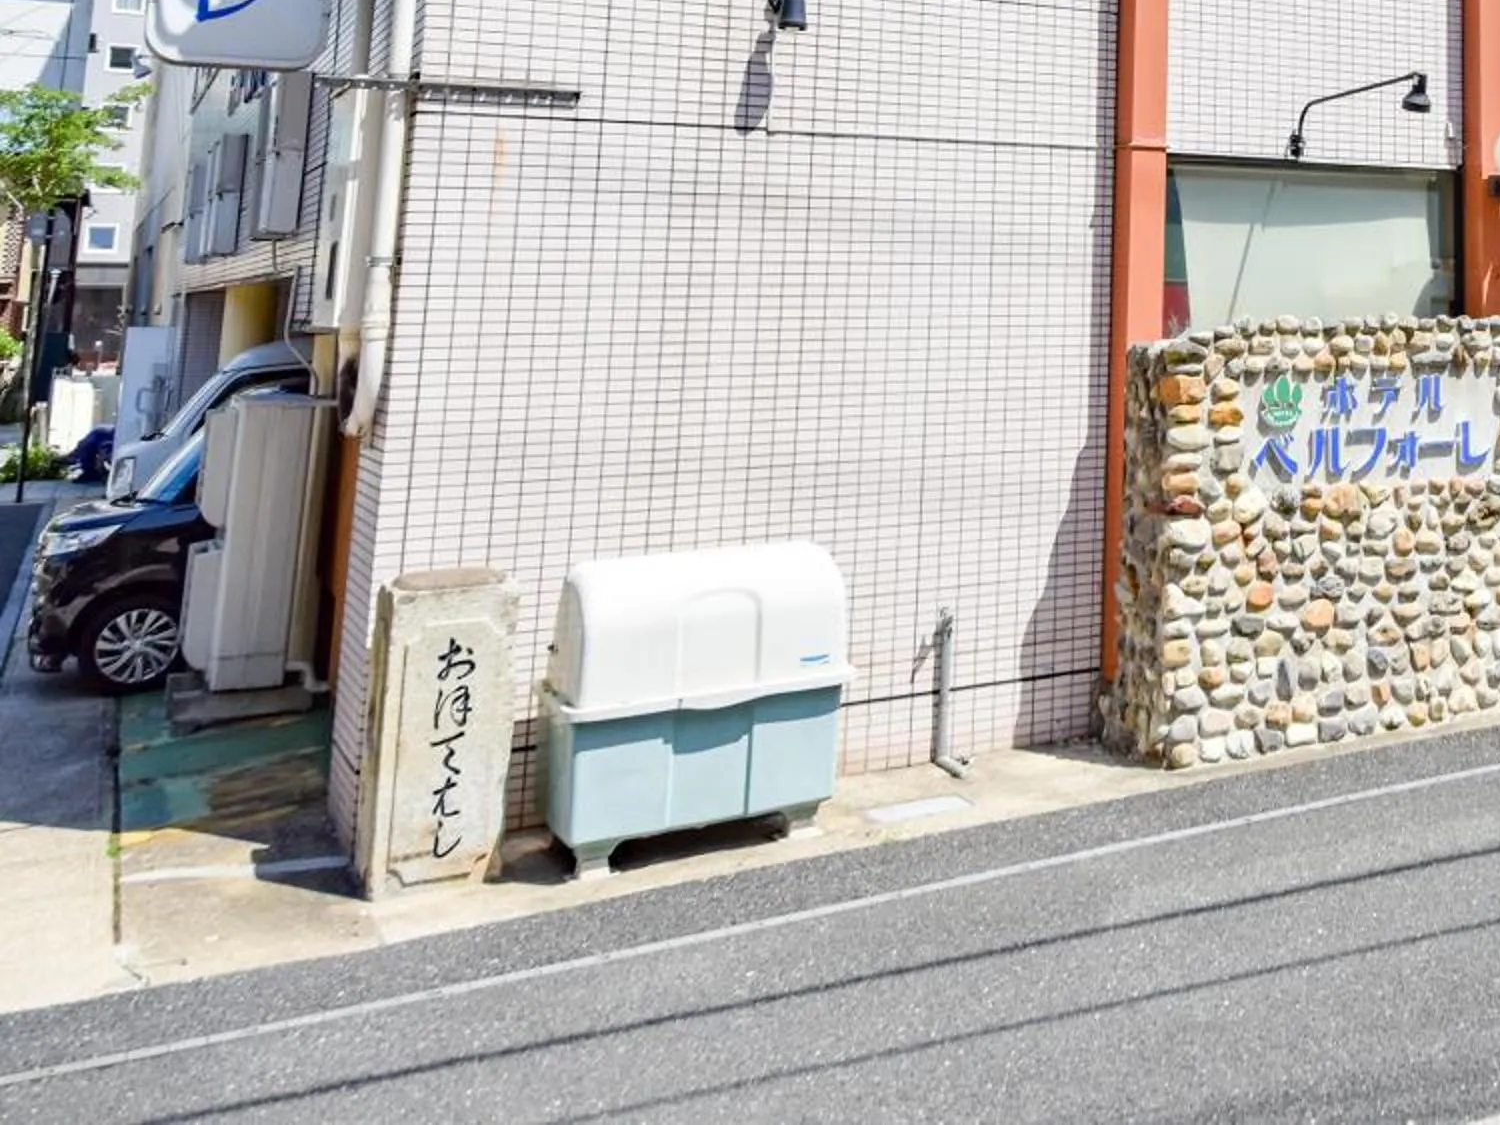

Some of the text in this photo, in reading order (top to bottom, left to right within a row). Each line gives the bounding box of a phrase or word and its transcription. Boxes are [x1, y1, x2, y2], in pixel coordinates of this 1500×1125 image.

[1322, 375, 1443, 418] ホテル
[1253, 421, 1490, 479] ベルフォーレ
